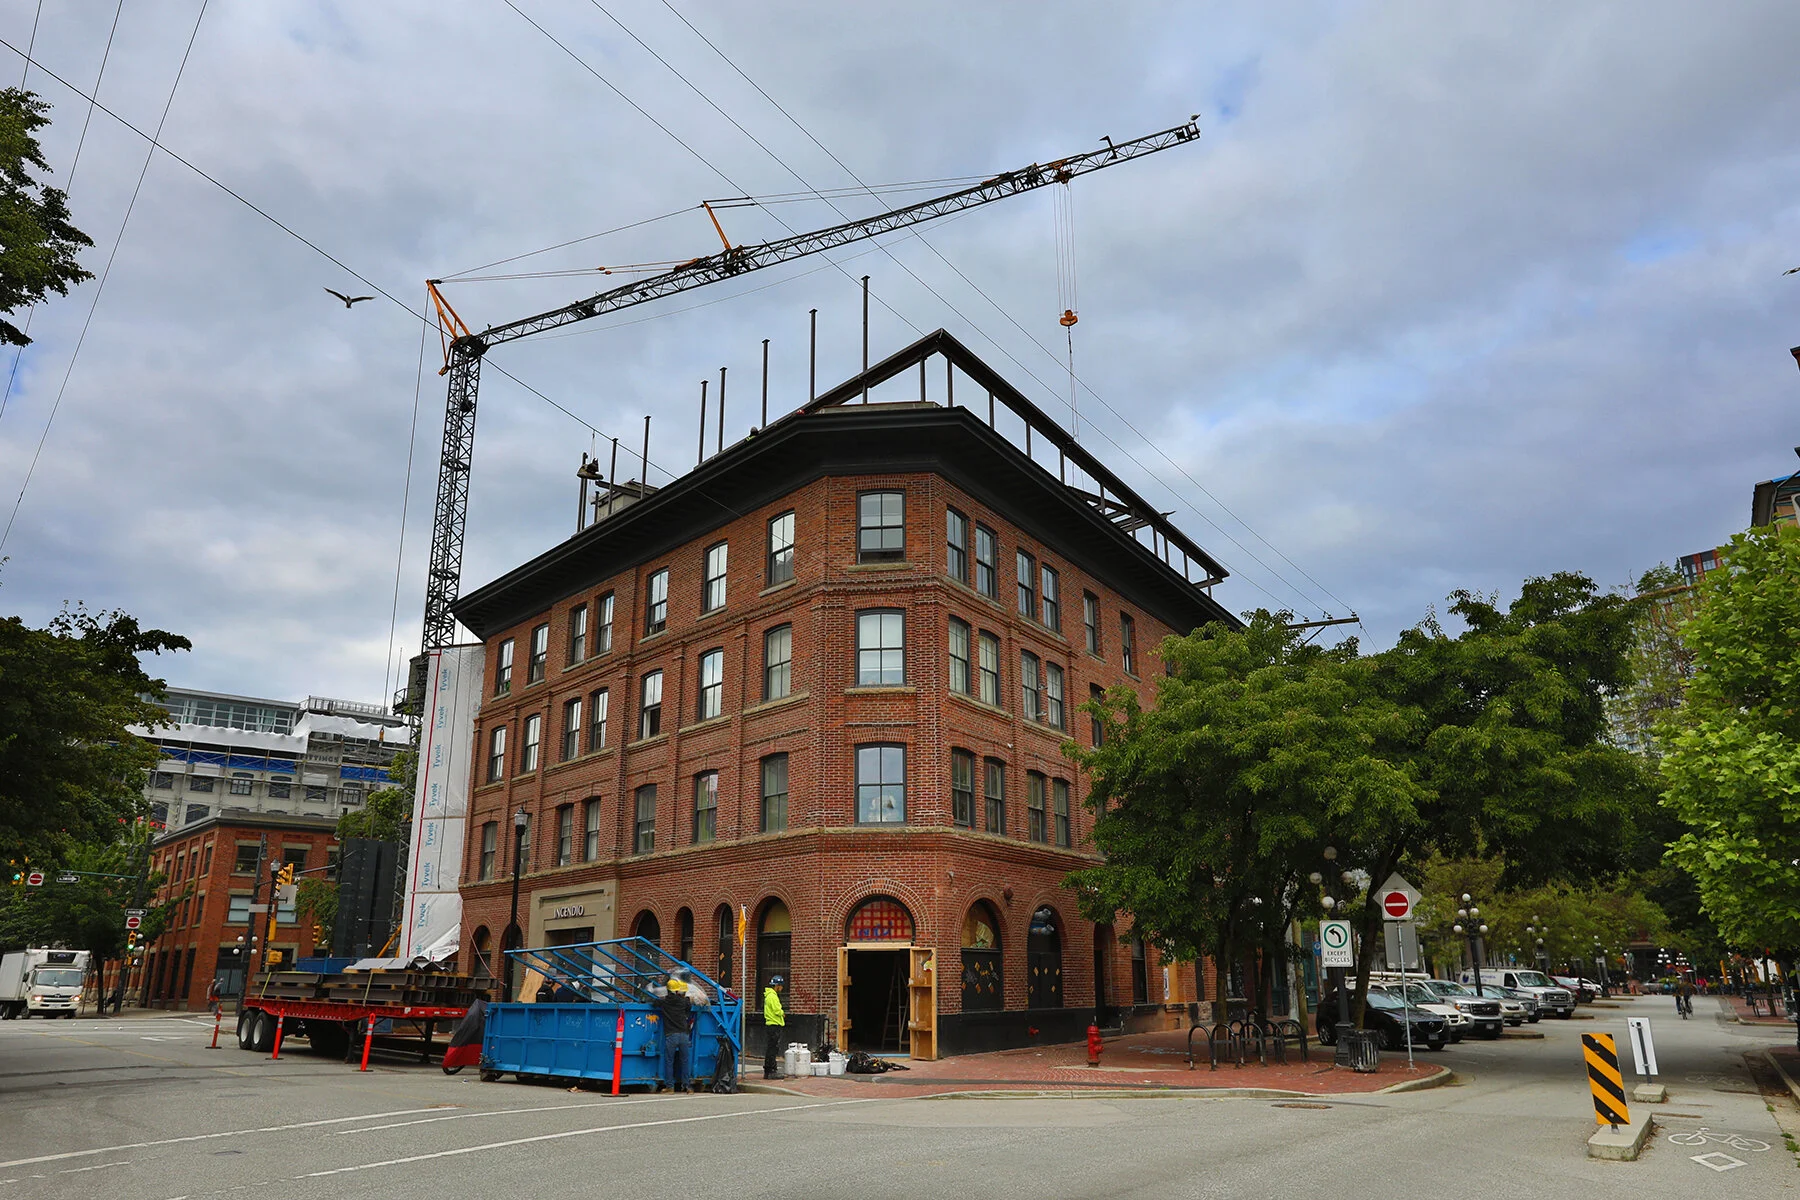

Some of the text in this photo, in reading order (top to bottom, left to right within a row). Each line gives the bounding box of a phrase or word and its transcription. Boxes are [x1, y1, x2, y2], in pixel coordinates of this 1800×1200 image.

[440, 668, 448, 692] Tyvek
[436, 706, 444, 729] Tyvek
[433, 744, 441, 768] Tyvek
[429, 782, 438, 807] Tyvek
[425, 822, 434, 847] Tyvek
[421, 862, 431, 887] Tyvek
[417, 903, 427, 929] Tyvek
[553, 904, 584, 919] INCENDIO
